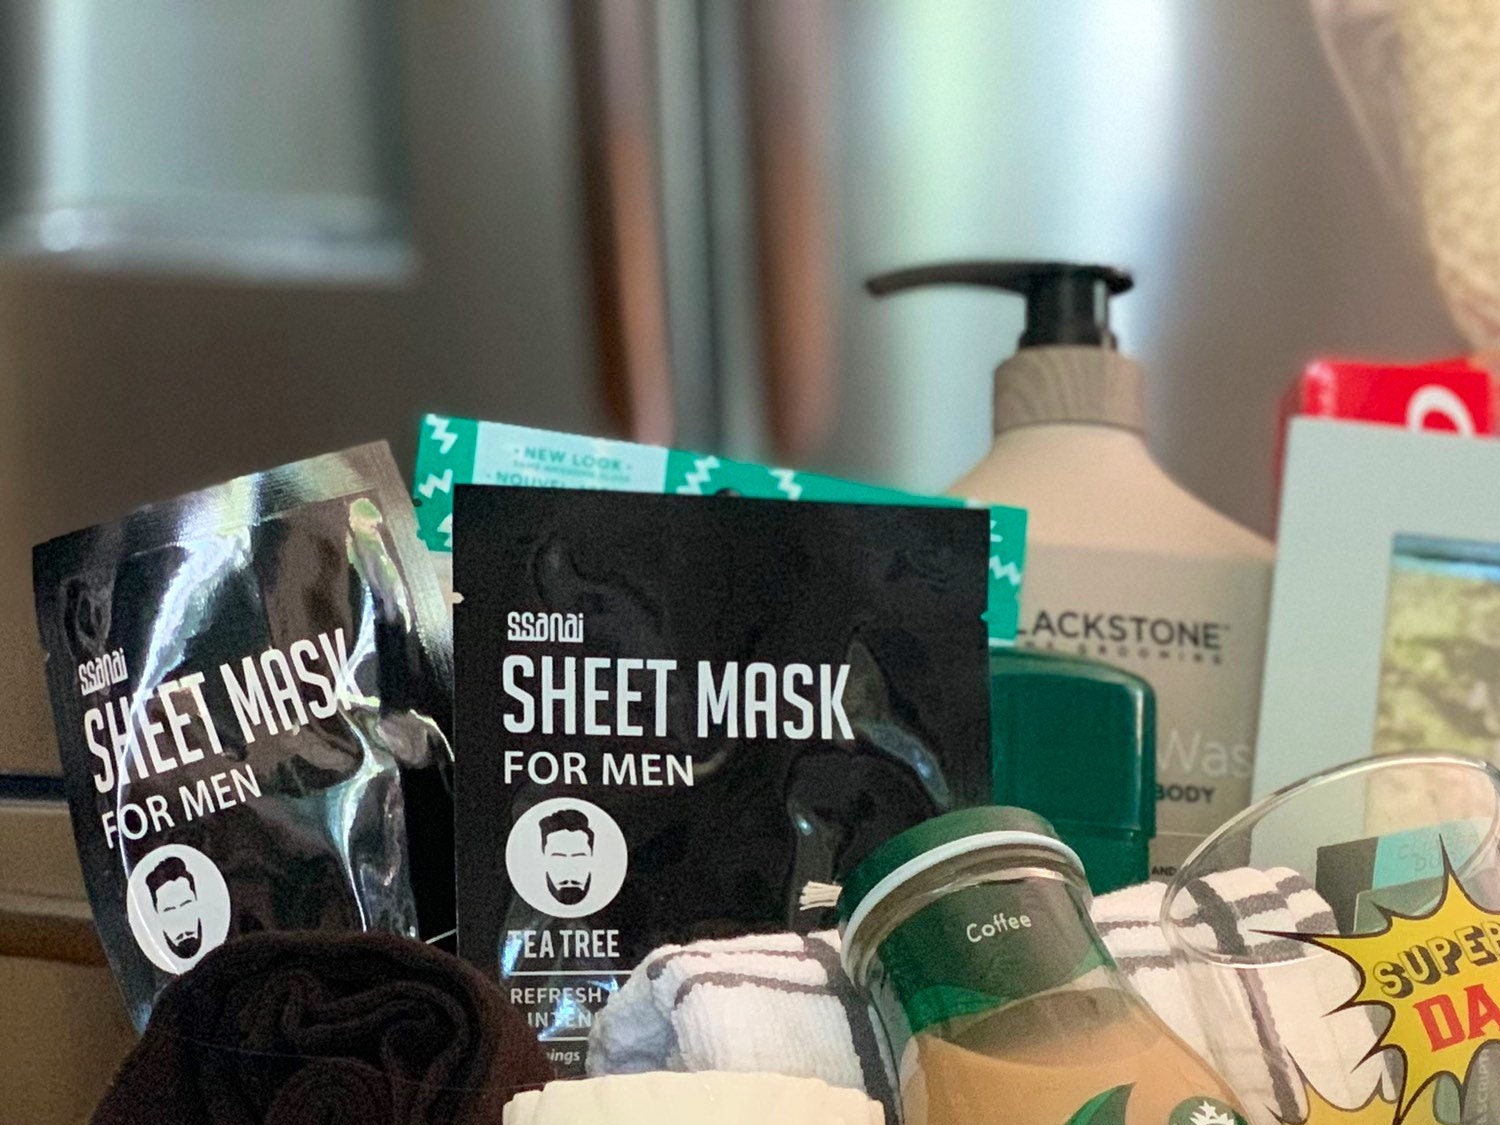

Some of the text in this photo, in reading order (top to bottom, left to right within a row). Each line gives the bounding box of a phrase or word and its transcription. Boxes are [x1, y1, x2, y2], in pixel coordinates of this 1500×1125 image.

[524, 446, 621, 470] NEW LOOK
[507, 611, 584, 643] ssanai
[1018, 610, 1222, 650] ACKSTONE
[78, 648, 128, 696] ssanai
[84, 627, 366, 794] SHEET MASK
[502, 654, 855, 740] SHEET MASK
[504, 750, 694, 787] FOR MEN
[1156, 728, 1251, 778] Was
[102, 764, 262, 849] FOR MEN
[507, 929, 621, 959] TEA TREE
[967, 913, 1032, 943] Coffee
[511, 987, 602, 1005] REFRESH
